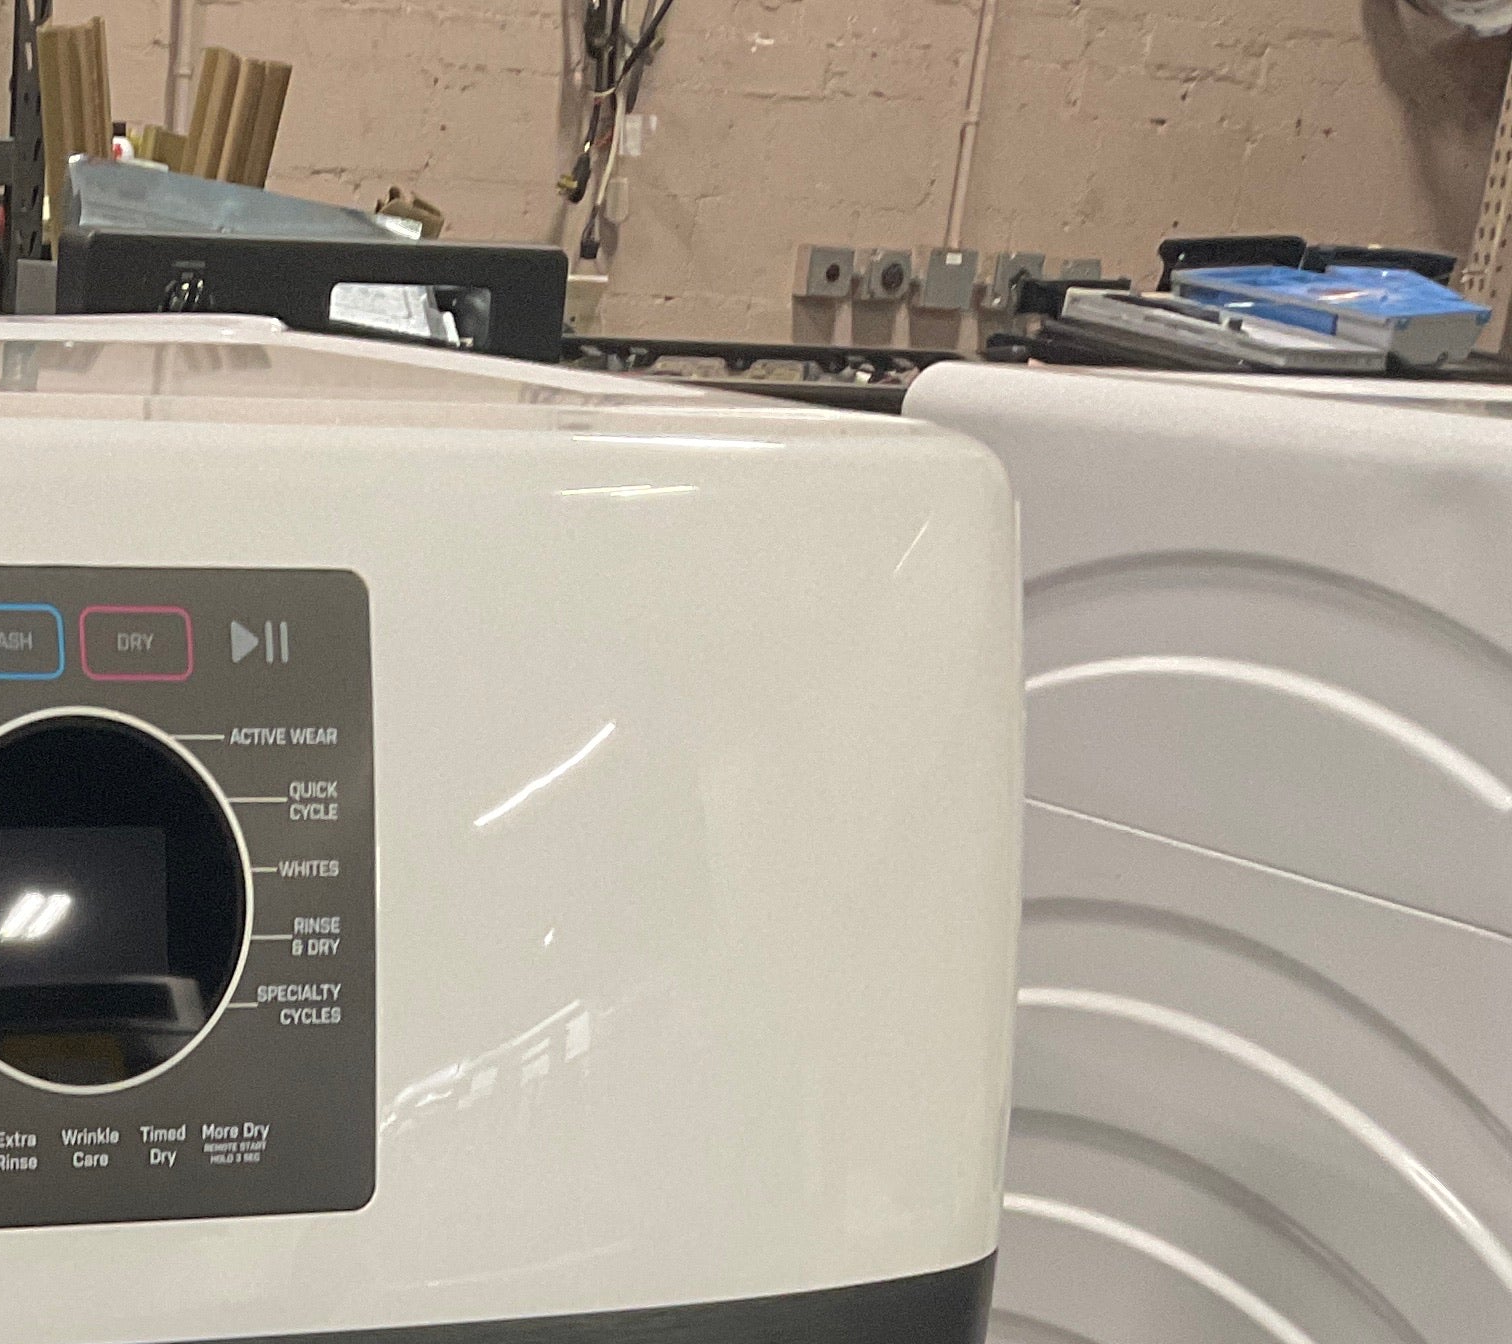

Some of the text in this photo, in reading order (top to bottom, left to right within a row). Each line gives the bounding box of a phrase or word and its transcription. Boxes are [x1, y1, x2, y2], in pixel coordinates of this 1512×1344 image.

[117, 632, 155, 652] DRY
[230, 727, 338, 745] ACTIVE WEAR
[289, 781, 338, 801] QUICK
[289, 803, 339, 821] CYCLE
[278, 859, 340, 878] WHITES
[293, 916, 341, 934] RINSE
[307, 938, 341, 956] DRY
[257, 983, 342, 1002] SPECIALTY
[280, 1006, 342, 1025] CYCLES
[61, 1127, 120, 1146] Wrinkle
[140, 1124, 187, 1143] Timed
[201, 1121, 270, 1140] More Dry
[72, 1151, 109, 1168] Care
[149, 1148, 177, 1168] Dry
